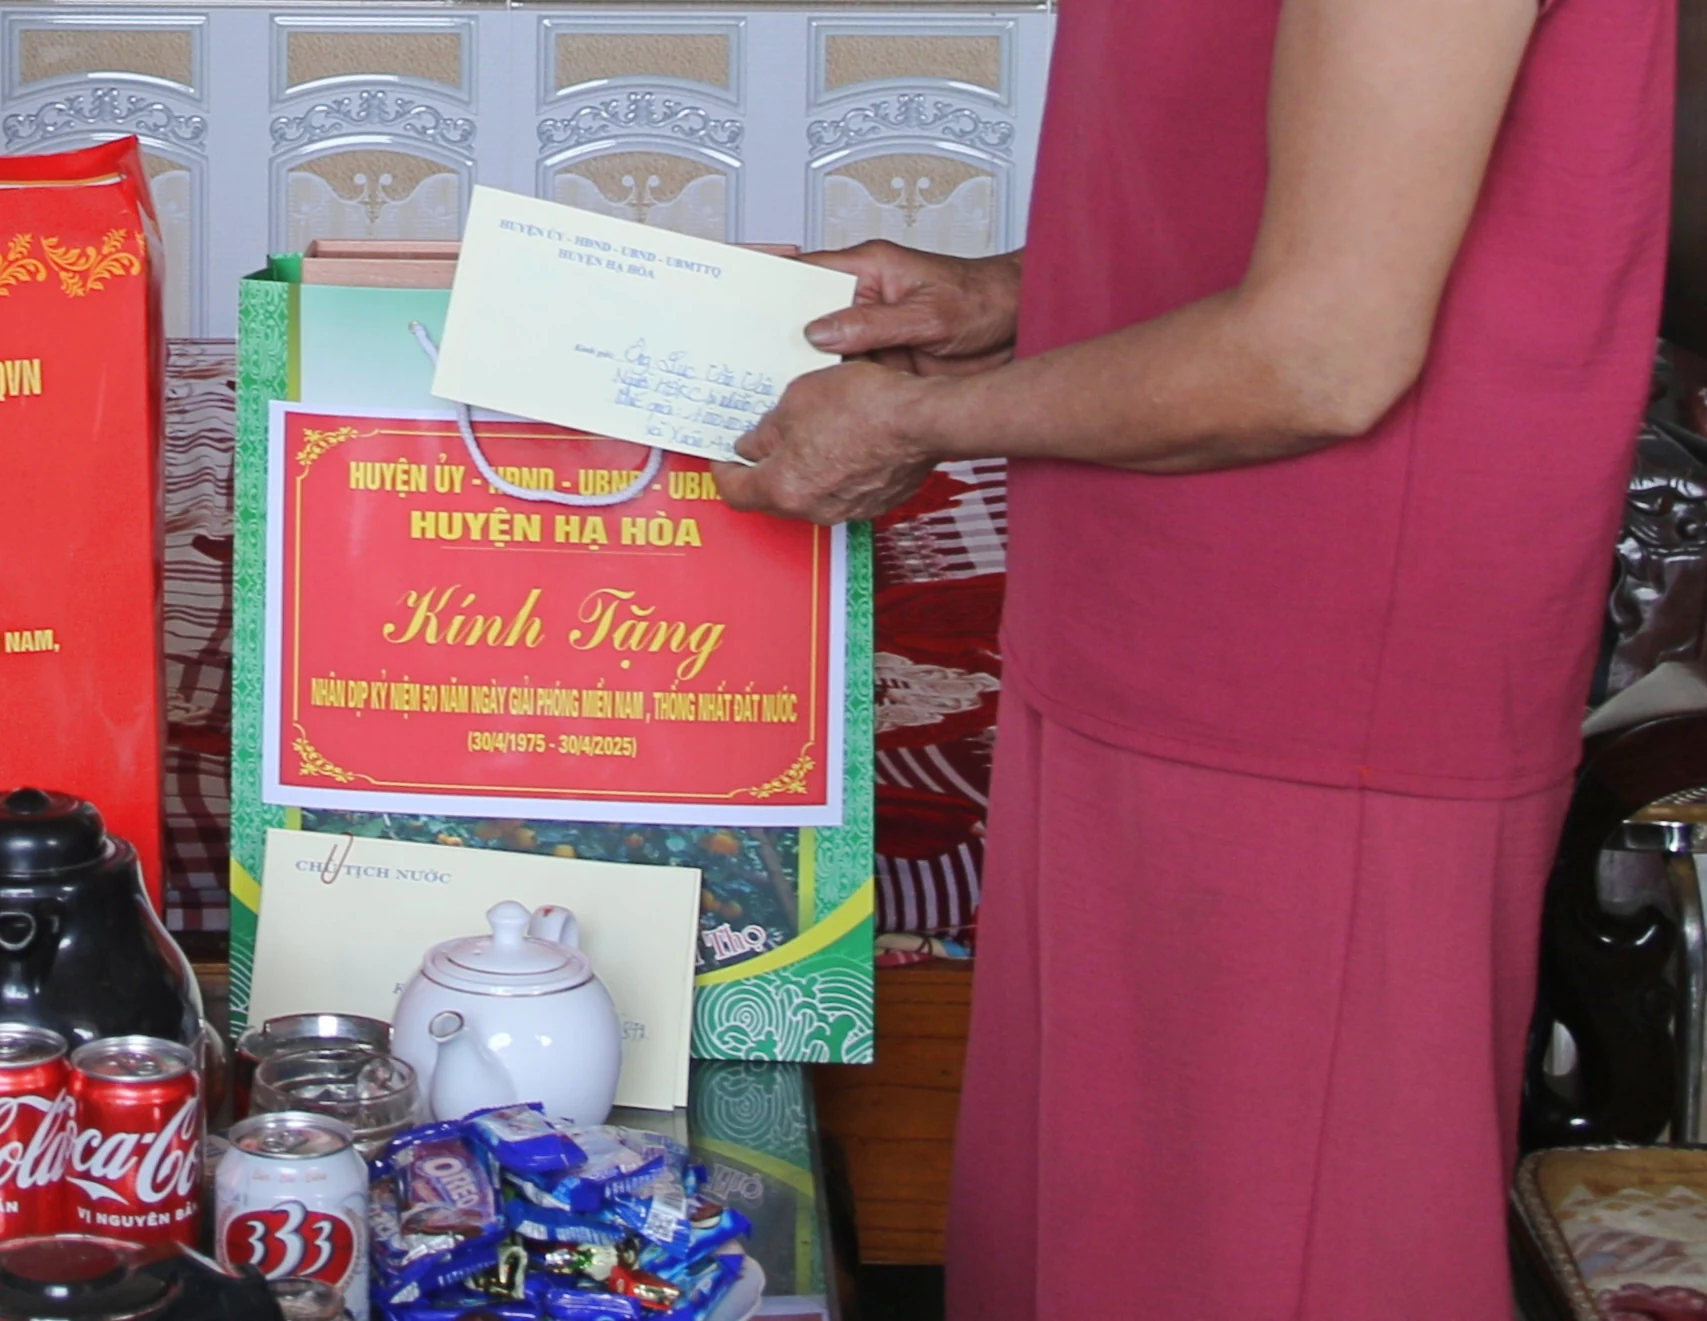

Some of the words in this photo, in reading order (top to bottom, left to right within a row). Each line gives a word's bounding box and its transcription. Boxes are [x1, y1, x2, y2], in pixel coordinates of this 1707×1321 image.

[665, 255, 722, 279] UBMTTQ
[349, 458, 428, 498] HUYỆN
[434, 453, 466, 494] ỦY
[410, 507, 541, 548] HUYỆN
[555, 515, 608, 551] HẠ
[620, 509, 702, 547] HÒA
[4, 629, 60, 654] NAM,
[383, 583, 545, 648] Kính
[568, 588, 726, 681] Tặng
[311, 671, 345, 707] NHÂN
[348, 680, 368, 718] DỊP
[423, 685, 438, 712] 50
[440, 677, 469, 713] NĂM
[471, 678, 507, 714] NGÀY
[509, 675, 534, 716] GIẢI
[536, 680, 579, 717] PHÓNG
[653, 679, 695, 722] THỐNG
[698, 680, 732, 722] NHẤT
[734, 681, 761, 723] ĐẤT
[467, 730, 546, 753] (30/4/1975
[558, 735, 637, 758] 30/4/2025)
[295, 856, 338, 875] CHỦ
[344, 864, 390, 879] TỊCH
[396, 868, 452, 884] NƯỚC
[701, 922, 767, 960] Thọ
[423, 1157, 480, 1209] OREO
[96, 1212, 170, 1227] NGUYÊN
[246, 1199, 334, 1281] 333
